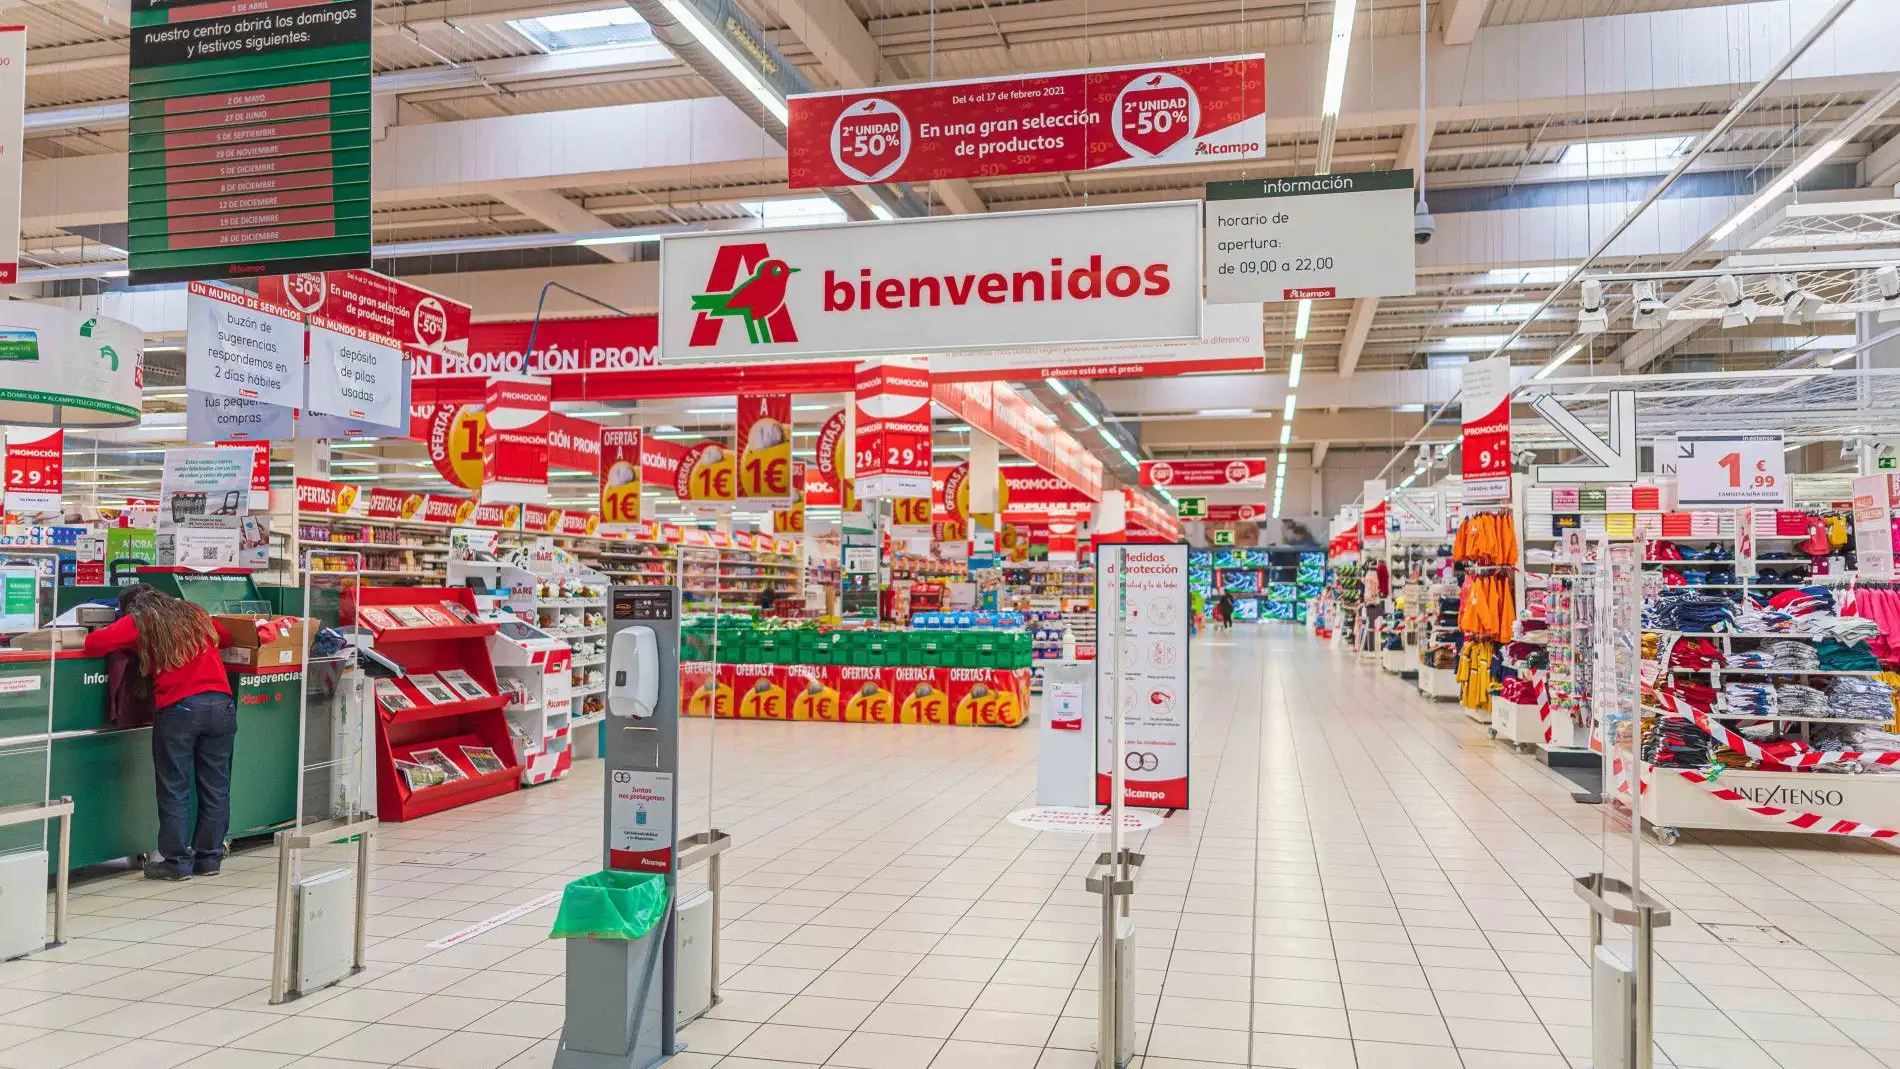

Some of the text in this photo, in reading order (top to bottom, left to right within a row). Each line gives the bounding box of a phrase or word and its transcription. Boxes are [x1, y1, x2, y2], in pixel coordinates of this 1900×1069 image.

[145, 8, 356, 43] nuestro centro abrirá los domingos
[187, 32, 310, 58] y festivos siguientes:
[227, 94, 265, 105] 2 DE MAYO
[952, 86, 1065, 104] Del 4 al 17 de febrero 2021
[1139, 98, 1187, 111] UNIDAD
[225, 111, 267, 122] 27 DE JUNIO
[920, 109, 1100, 138] En una gran selección
[1125, 110, 1187, 135] -50%
[216, 128, 276, 140] 5 DE SEPTIEMBRE
[855, 123, 898, 135] UNIDAD
[215, 145, 279, 158] 28 DE NOVIEMBRE
[842, 134, 900, 156] -50%
[954, 134, 1065, 158] de productos
[1194, 140, 1259, 156] Alcampo
[220, 163, 276, 175] 5 DE DICIEMBRE
[221, 180, 276, 192] 8 DE DICIEMBRE
[1264, 176, 1353, 194] información
[219, 197, 278, 209] 12 DE DICIEMBRE
[220, 214, 279, 226] 19 DE DICIEMBRE
[1218, 213, 1289, 227] horario de
[220, 231, 279, 243] 26 DE DICIEMBRE
[1218, 238, 1282, 254] apertura:
[1218, 257, 1333, 275] de 09,00 a 22,00
[289, 279, 320, 295] -50%
[823, 254, 1171, 311] bienvenidos
[191, 283, 301, 321] UN MUNDO DE SERVICIOS
[330, 284, 410, 318] En una gran selección
[227, 312, 272, 333] buzón de
[346, 305, 395, 326] de productos
[312, 316, 401, 349] UN MUNDO DE SERVICIOS
[419, 319, 442, 335] -50%
[208, 347, 287, 373] respondemos en
[340, 346, 376, 365] depósito
[215, 366, 281, 389] 2 días hábiles
[341, 366, 375, 383] de pilas
[1041, 368, 1050, 376] El
[1051, 368, 1078, 376] ahorro
[1079, 366, 1097, 375] está
[1108, 365, 1117, 373] el
[1118, 364, 1143, 375] precio
[886, 378, 928, 388] PROMOCIÓN
[8, 392, 40, 400] DOMICILIO
[341, 388, 374, 402] usadas
[502, 392, 547, 402] PROMOCIÓN
[760, 398, 768, 415] A
[217, 413, 261, 425] compras
[885, 423, 929, 433] PROMOCIÓN
[500, 434, 546, 444] PROMOCIÓN
[604, 431, 637, 445] OFERTAS
[10, 449, 60, 458] PROMOCIÓN
[617, 446, 623, 460] A
[888, 448, 913, 464] 29
[1480, 451, 1491, 468] 9
[11, 469, 41, 484] 29
[746, 458, 787, 494] 1€
[1718, 452, 1766, 488] 1 €
[699, 468, 732, 497] 1€
[1749, 475, 1775, 489] ,99
[298, 486, 329, 504] OFERTAS
[330, 491, 336, 504] A
[607, 493, 638, 520] 1€
[898, 498, 928, 522] 1€
[736, 664, 774, 676] OFERTAS A
[789, 665, 827, 678] OFERTAS A
[750, 695, 779, 717] 1€
[803, 697, 832, 720] 1€
[856, 699, 887, 722] 1€
[910, 700, 941, 723] 1€
[641, 858, 666, 866] Alcampo
